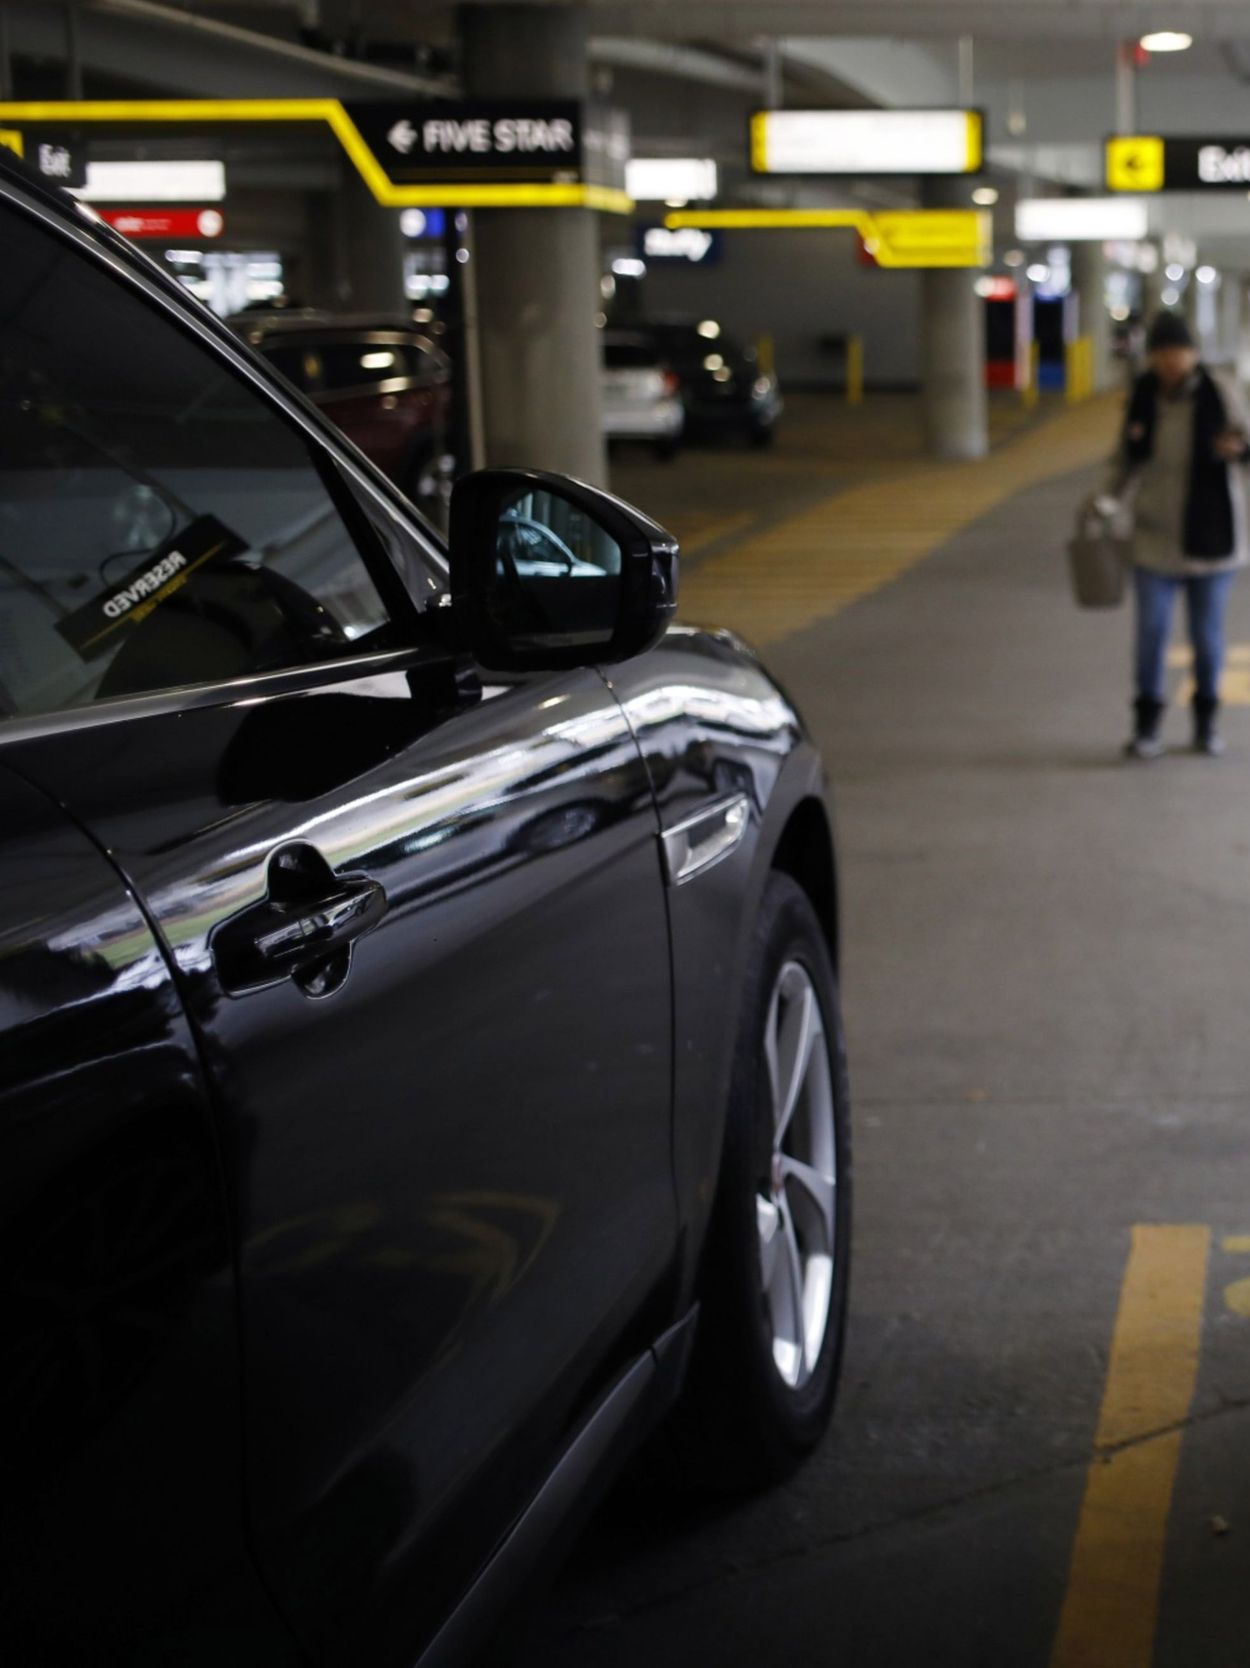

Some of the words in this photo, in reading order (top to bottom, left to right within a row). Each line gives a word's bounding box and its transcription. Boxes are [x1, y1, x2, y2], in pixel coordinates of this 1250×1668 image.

[423, 118, 491, 152] FIVE
[493, 118, 574, 152] STAR
[40, 143, 71, 177] Exit
